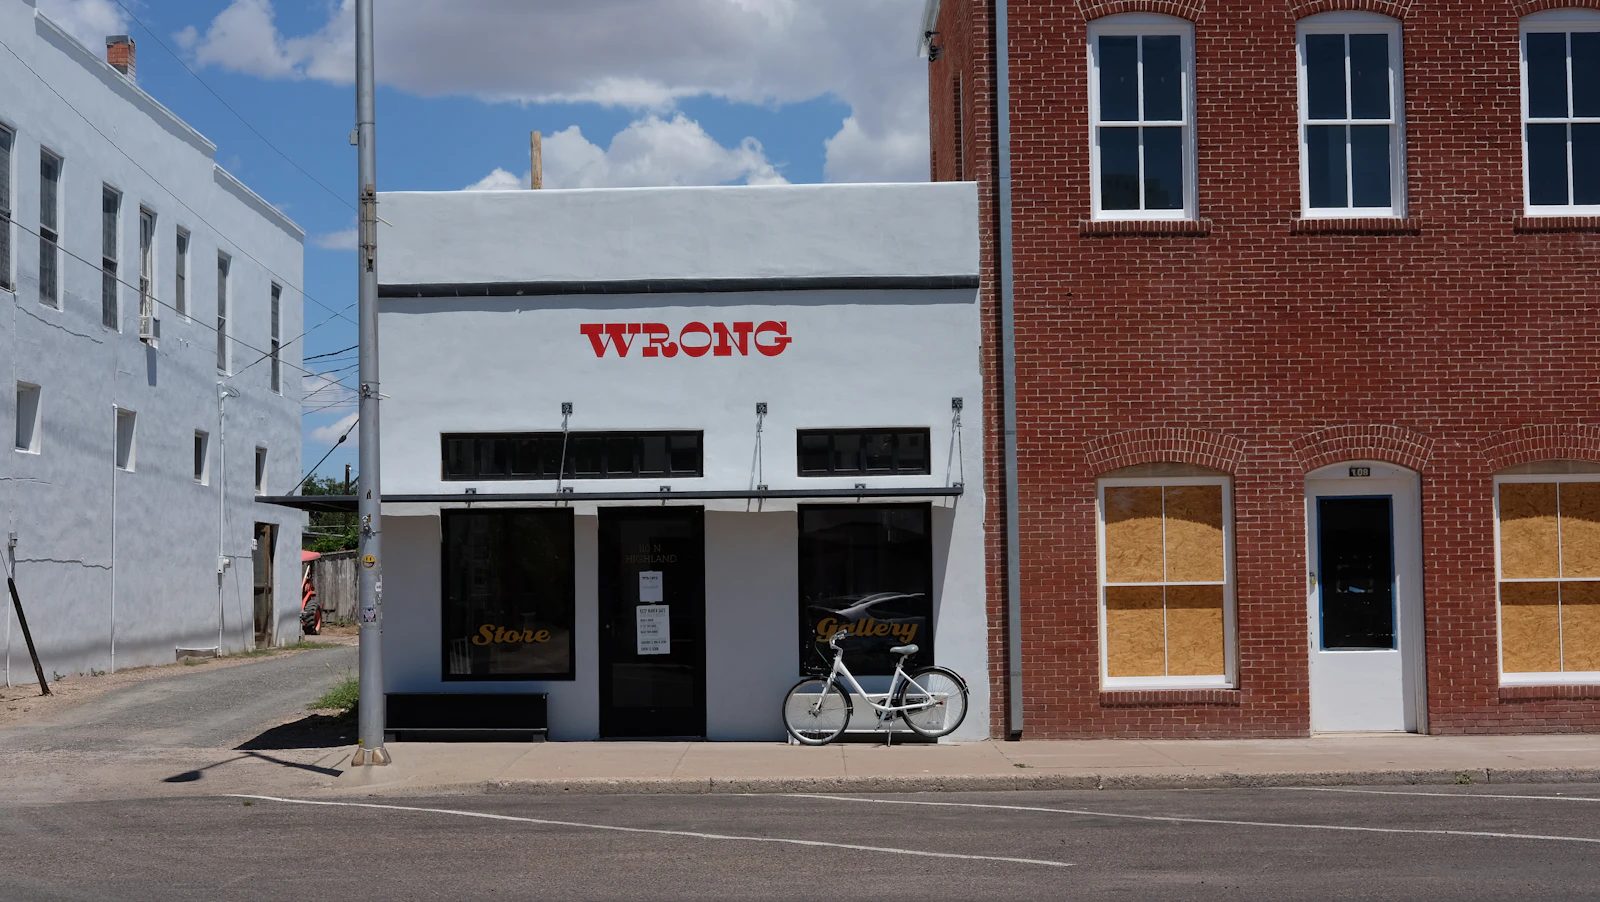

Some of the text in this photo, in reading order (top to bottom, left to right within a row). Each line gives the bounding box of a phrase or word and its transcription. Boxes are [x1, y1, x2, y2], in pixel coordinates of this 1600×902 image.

[580, 320, 792, 358] WRONG
[1350, 468, 1369, 476] 108
[638, 544, 661, 553] 110 N
[625, 554, 677, 563] HIGHLAND
[471, 623, 551, 646] Store
[816, 617, 919, 643] Gallery
